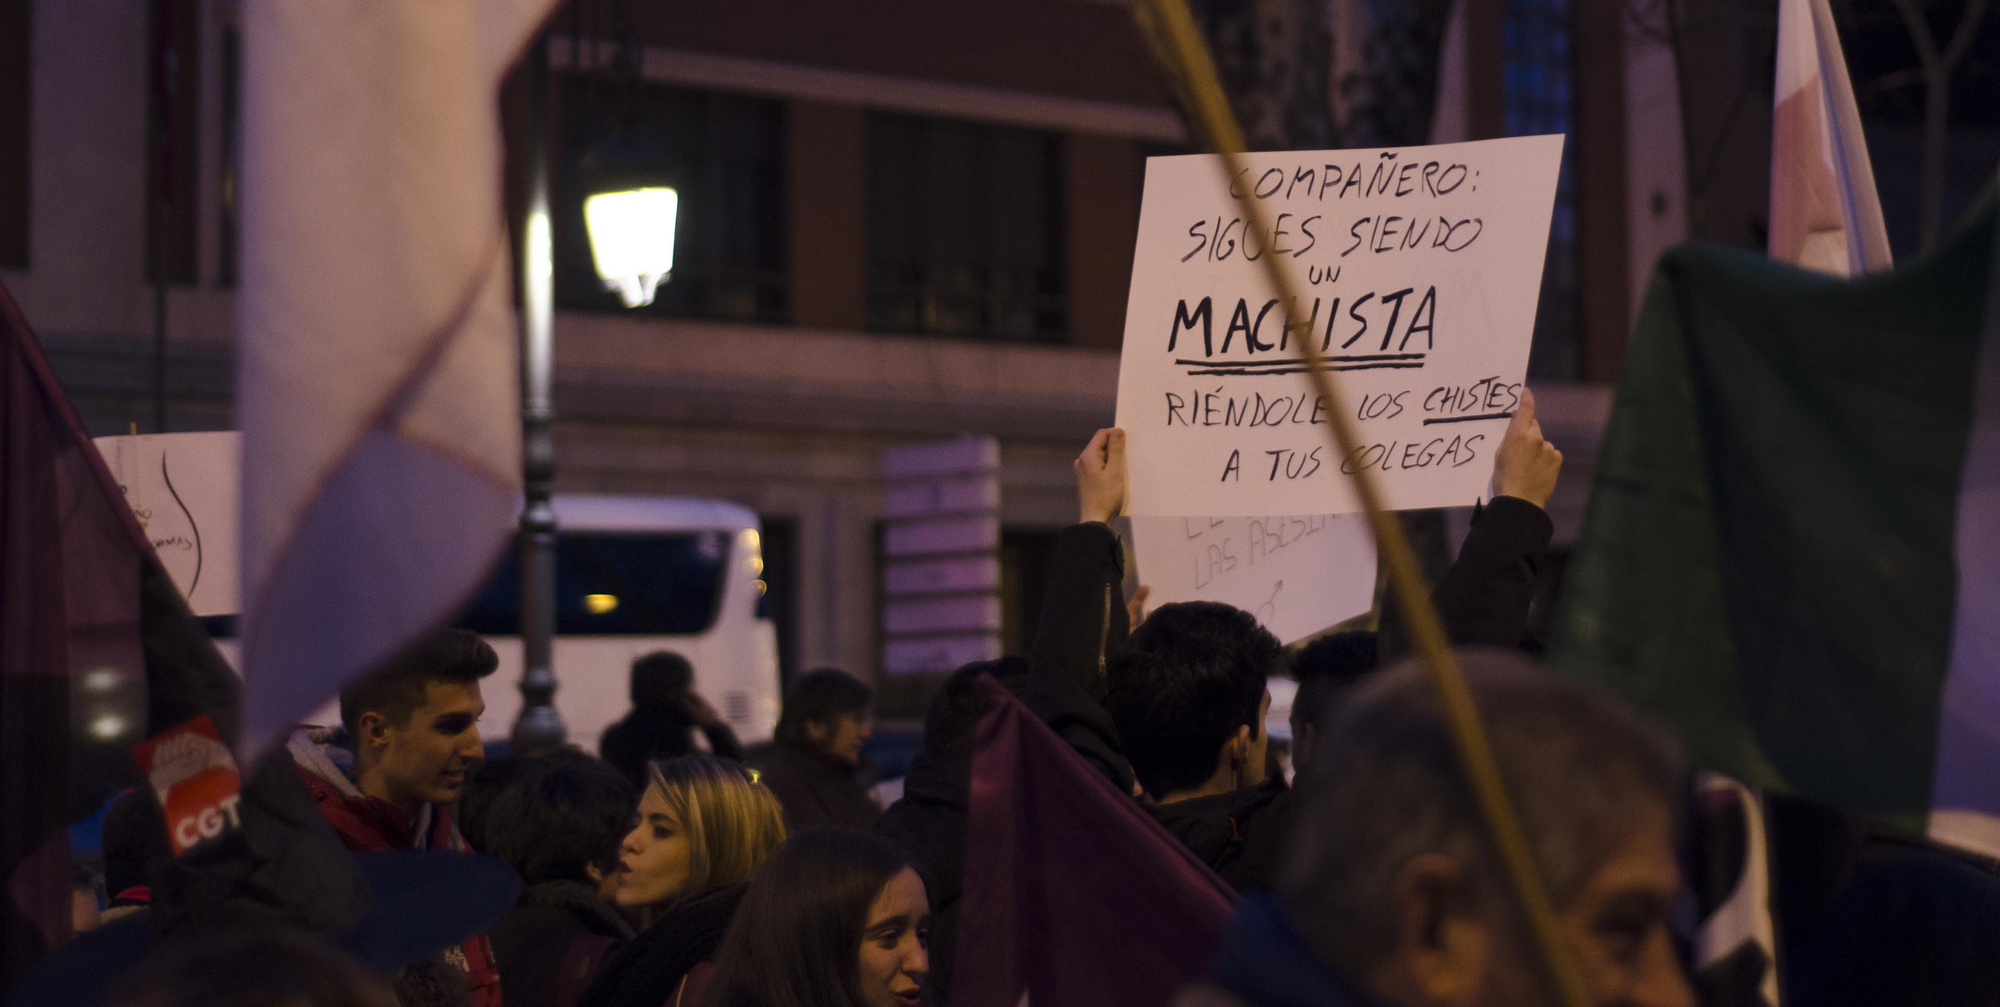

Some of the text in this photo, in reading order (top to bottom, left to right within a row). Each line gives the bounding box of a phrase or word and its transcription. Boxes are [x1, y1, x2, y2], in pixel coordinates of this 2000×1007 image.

[1229, 152, 1480, 201] COMPAÑERO:
[1180, 213, 1483, 263] SIGUES SIENDO
[1308, 265, 1341, 285] UN
[1167, 284, 1436, 357] MACHISTA
[1165, 376, 1522, 426] RIÉNDOLE LOS CHISTES
[1220, 434, 1485, 482] A TUS COLEGAS
[175, 793, 242, 848] CGT
